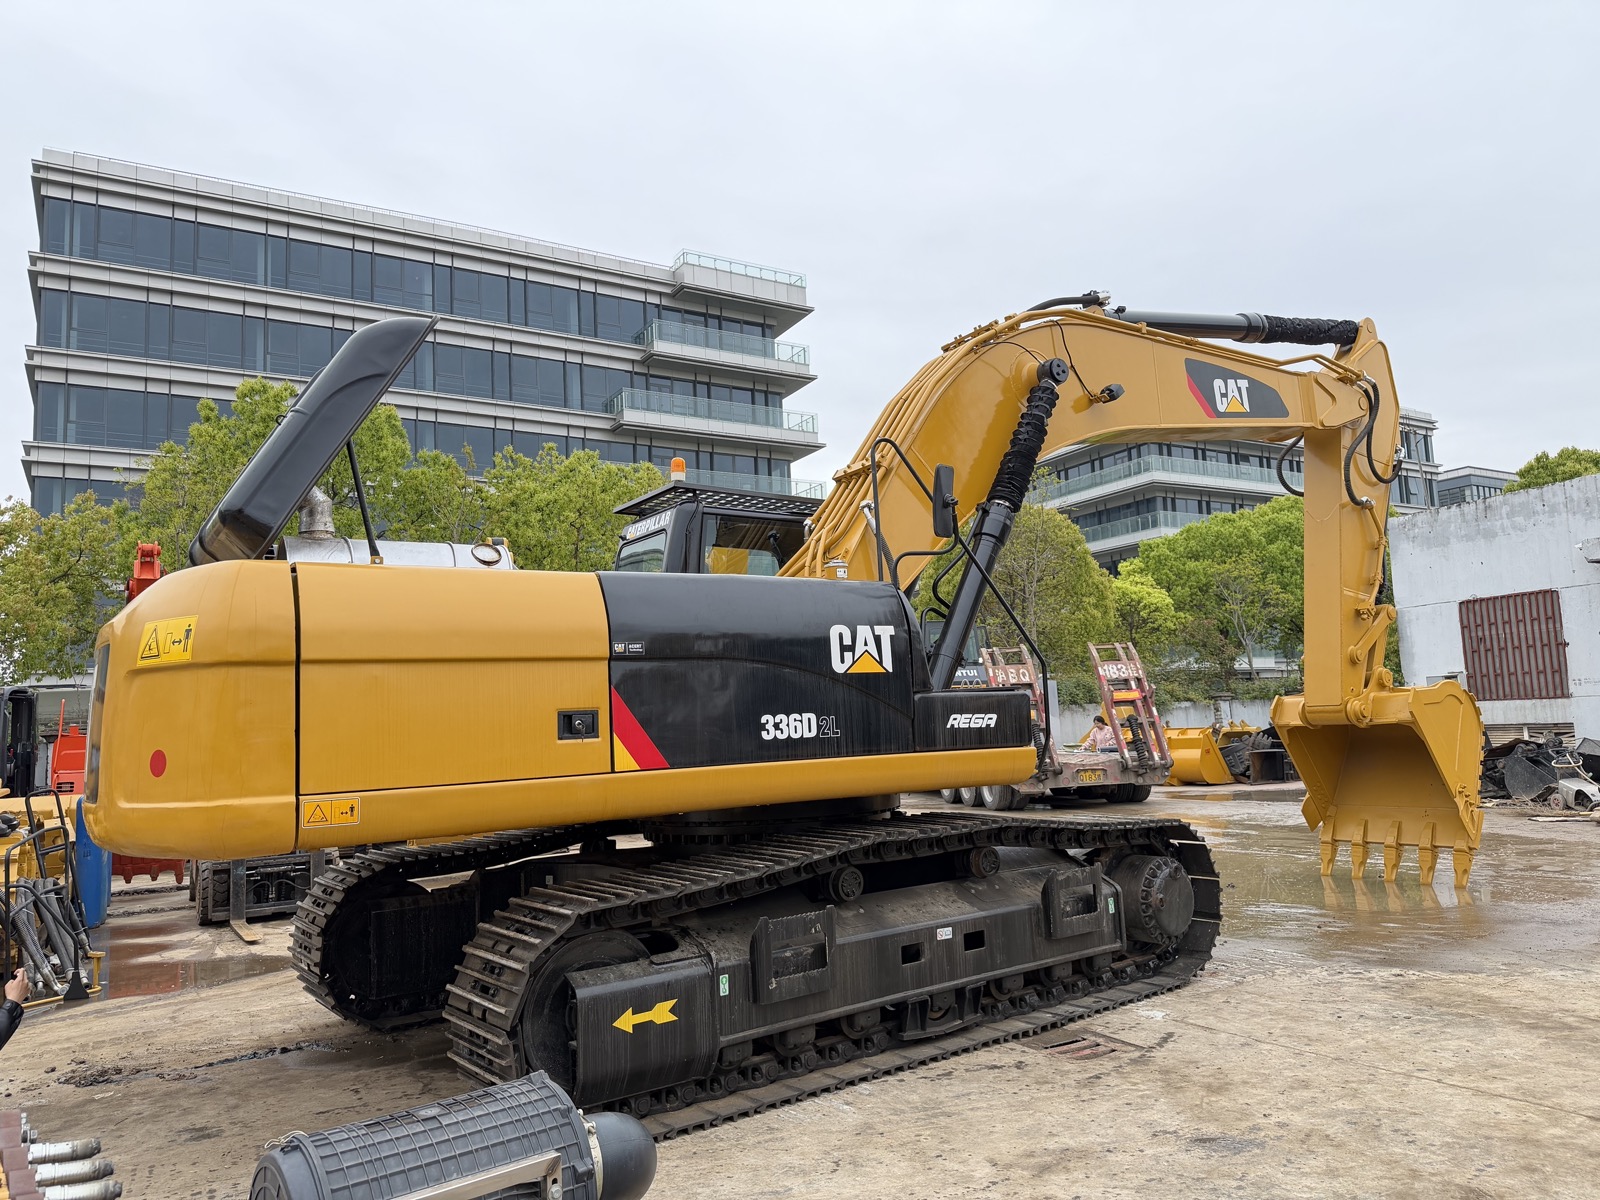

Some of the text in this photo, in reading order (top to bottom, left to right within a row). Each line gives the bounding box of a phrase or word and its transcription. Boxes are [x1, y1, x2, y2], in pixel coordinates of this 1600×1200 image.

[1213, 378, 1250, 413] CAT
[626, 511, 671, 540] CATERPILLAR
[614, 643, 625, 652] CAT
[830, 624, 895, 674] CAT
[946, 713, 998, 728] REGA
